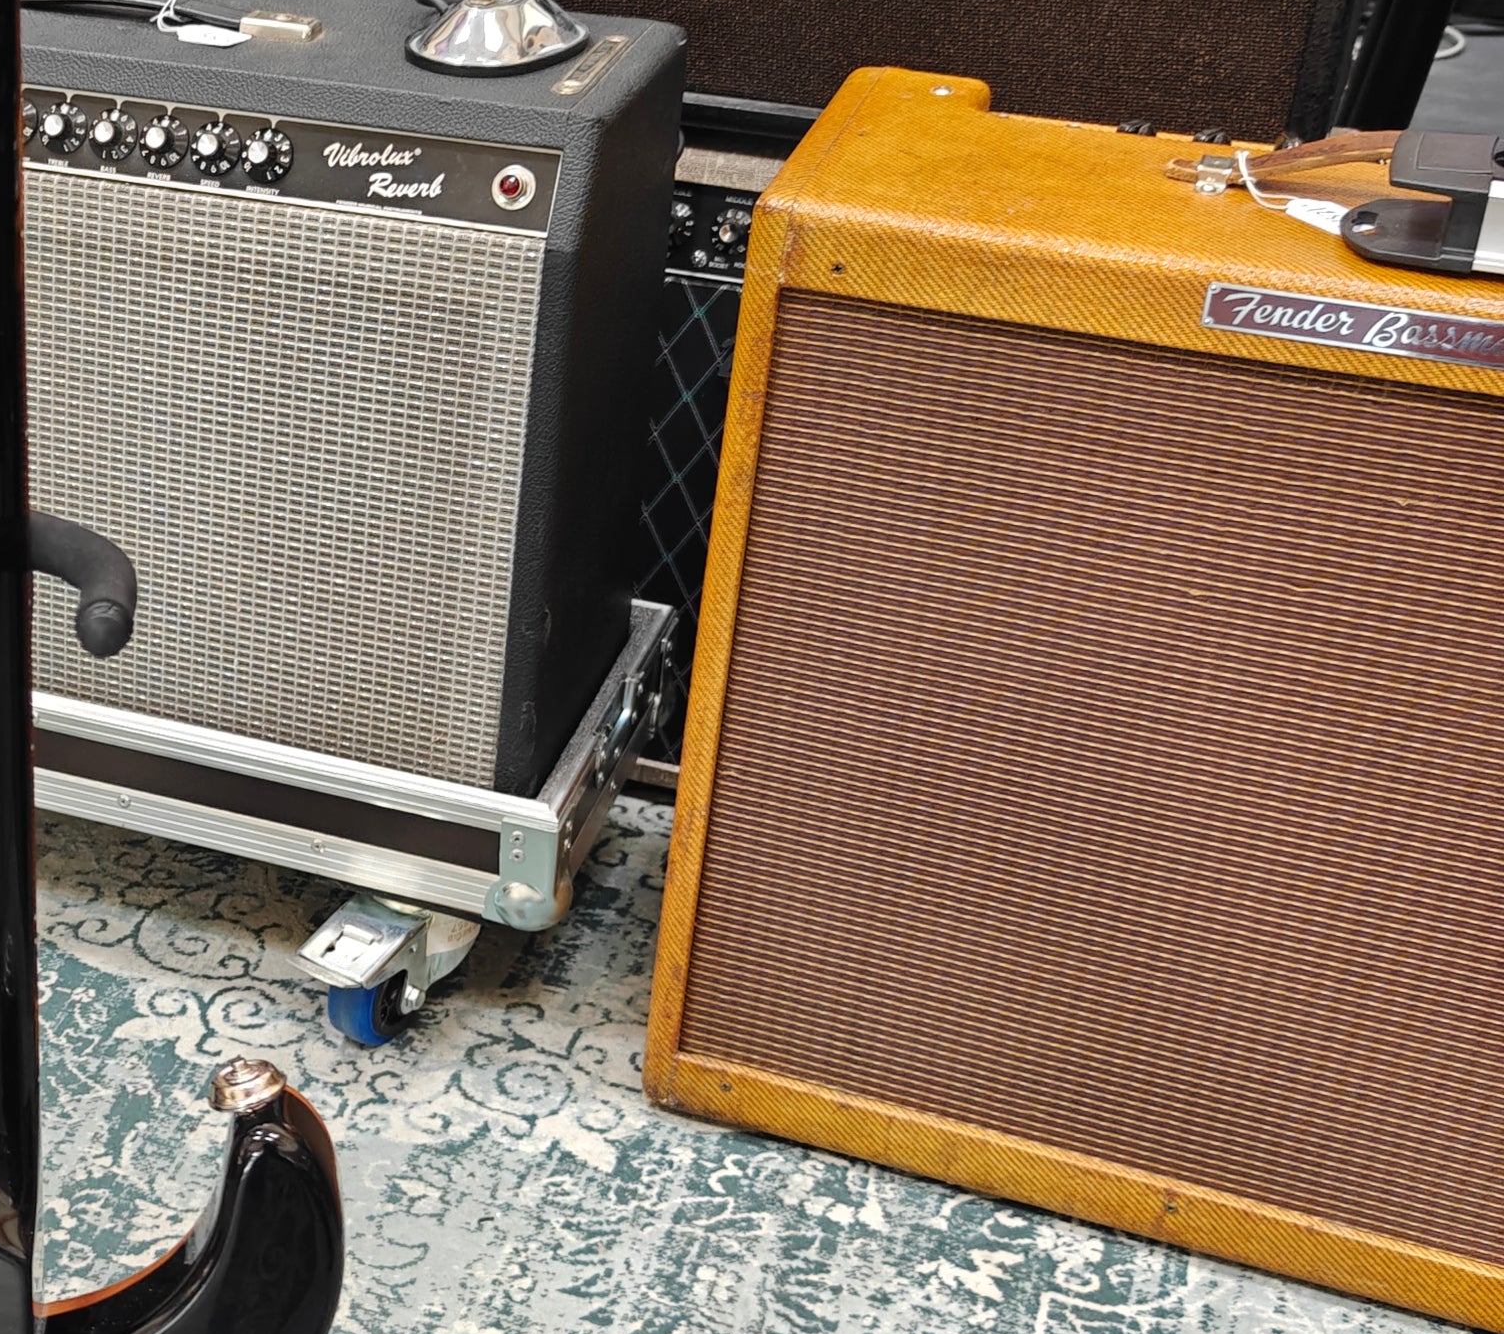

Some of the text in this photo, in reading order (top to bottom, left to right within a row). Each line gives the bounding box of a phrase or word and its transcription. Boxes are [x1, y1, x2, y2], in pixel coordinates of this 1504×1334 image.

[100, 165, 116, 174] BASS
[147, 171, 171, 181] REVERB
[200, 179, 220, 188] SPEED
[367, 172, 446, 198] Reverb
[1223, 293, 1354, 335] Fender
